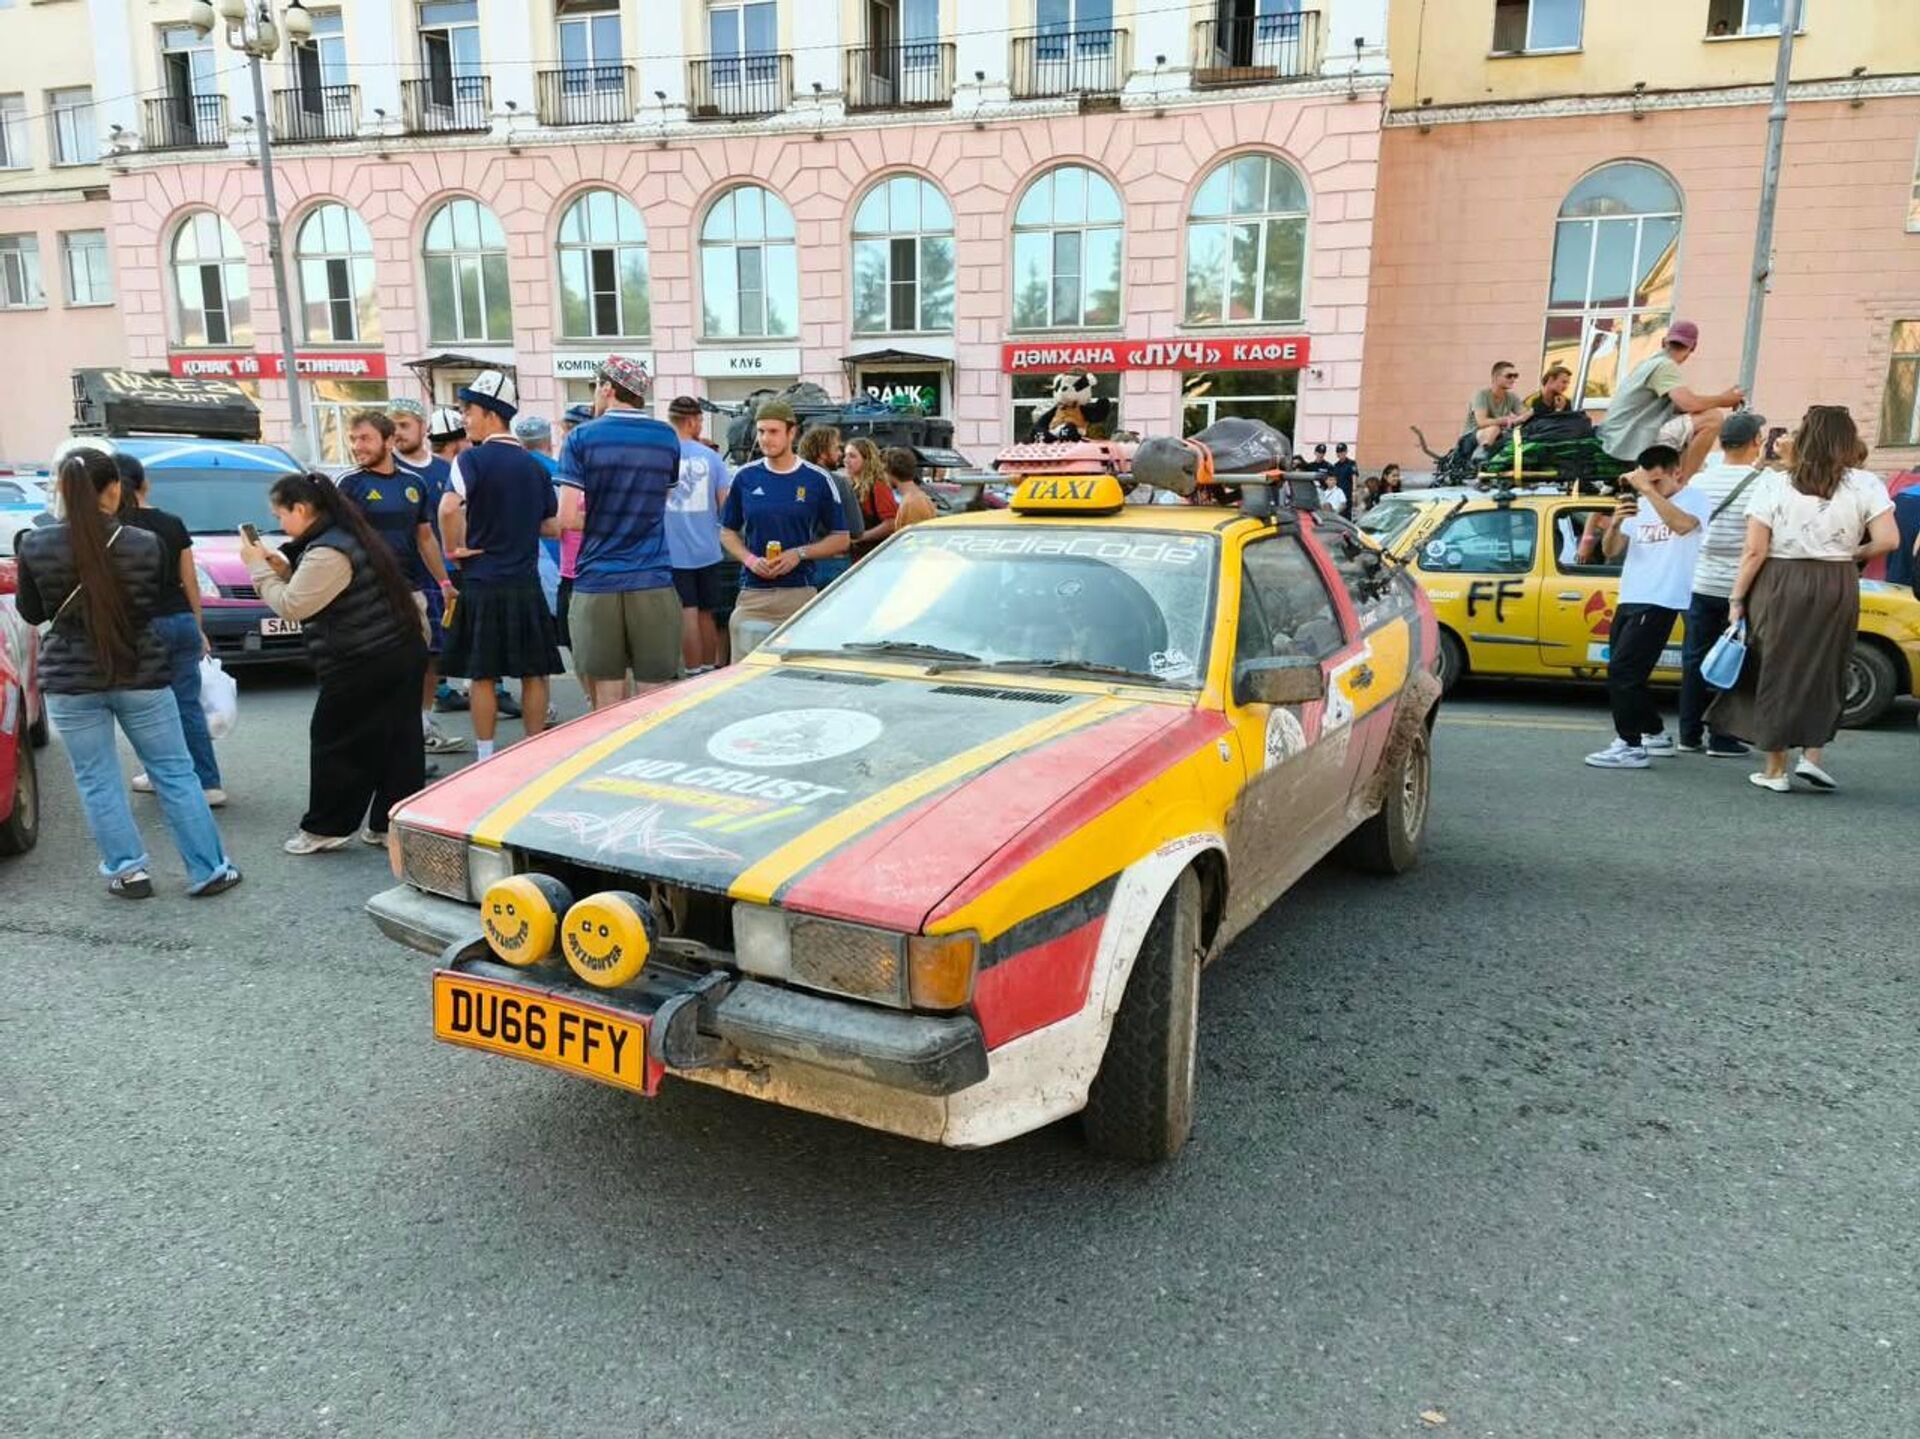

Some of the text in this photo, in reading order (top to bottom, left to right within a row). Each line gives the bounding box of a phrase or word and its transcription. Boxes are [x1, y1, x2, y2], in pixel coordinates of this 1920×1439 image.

[276, 359, 369, 375] ГСТИНИЦА
[730, 357, 762, 369] КЛУБ
[1012, 348, 1115, 368] ДӘМХАНА
[1233, 344, 1297, 361] КАФЕ
[1024, 479, 1099, 500] TAXI
[943, 534, 1198, 565] RadiaCode
[1467, 579, 1524, 623] FF
[604, 758, 688, 780] NO
[672, 766, 848, 805] CRUST
[450, 987, 629, 1074] DU66 FFY
